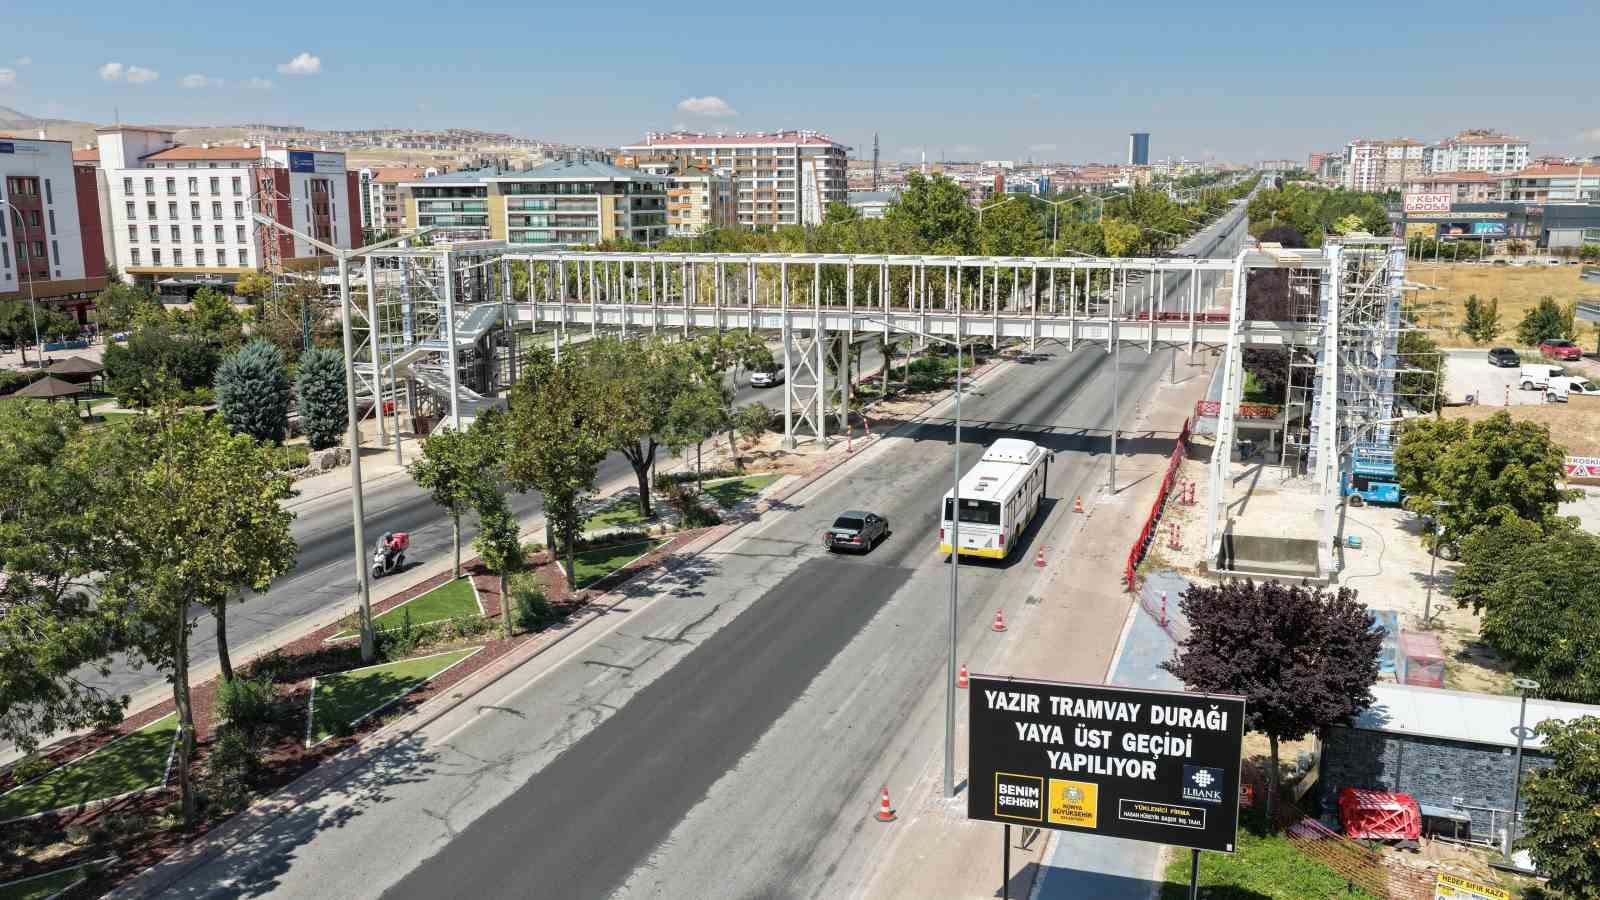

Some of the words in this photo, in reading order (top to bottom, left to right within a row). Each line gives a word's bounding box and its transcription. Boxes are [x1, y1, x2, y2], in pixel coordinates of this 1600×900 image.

[985, 689, 1040, 714] YAZIR
[1049, 696, 1141, 722] TRAMVAY
[1150, 704, 1228, 731] DURAĞI
[1015, 722, 1064, 745] YAYA
[1074, 723, 1112, 750] ÜST
[1122, 731, 1192, 760] GEÇİDİ
[1047, 750, 1157, 781] YAPILIYOR
[999, 783, 1039, 798] BENİM
